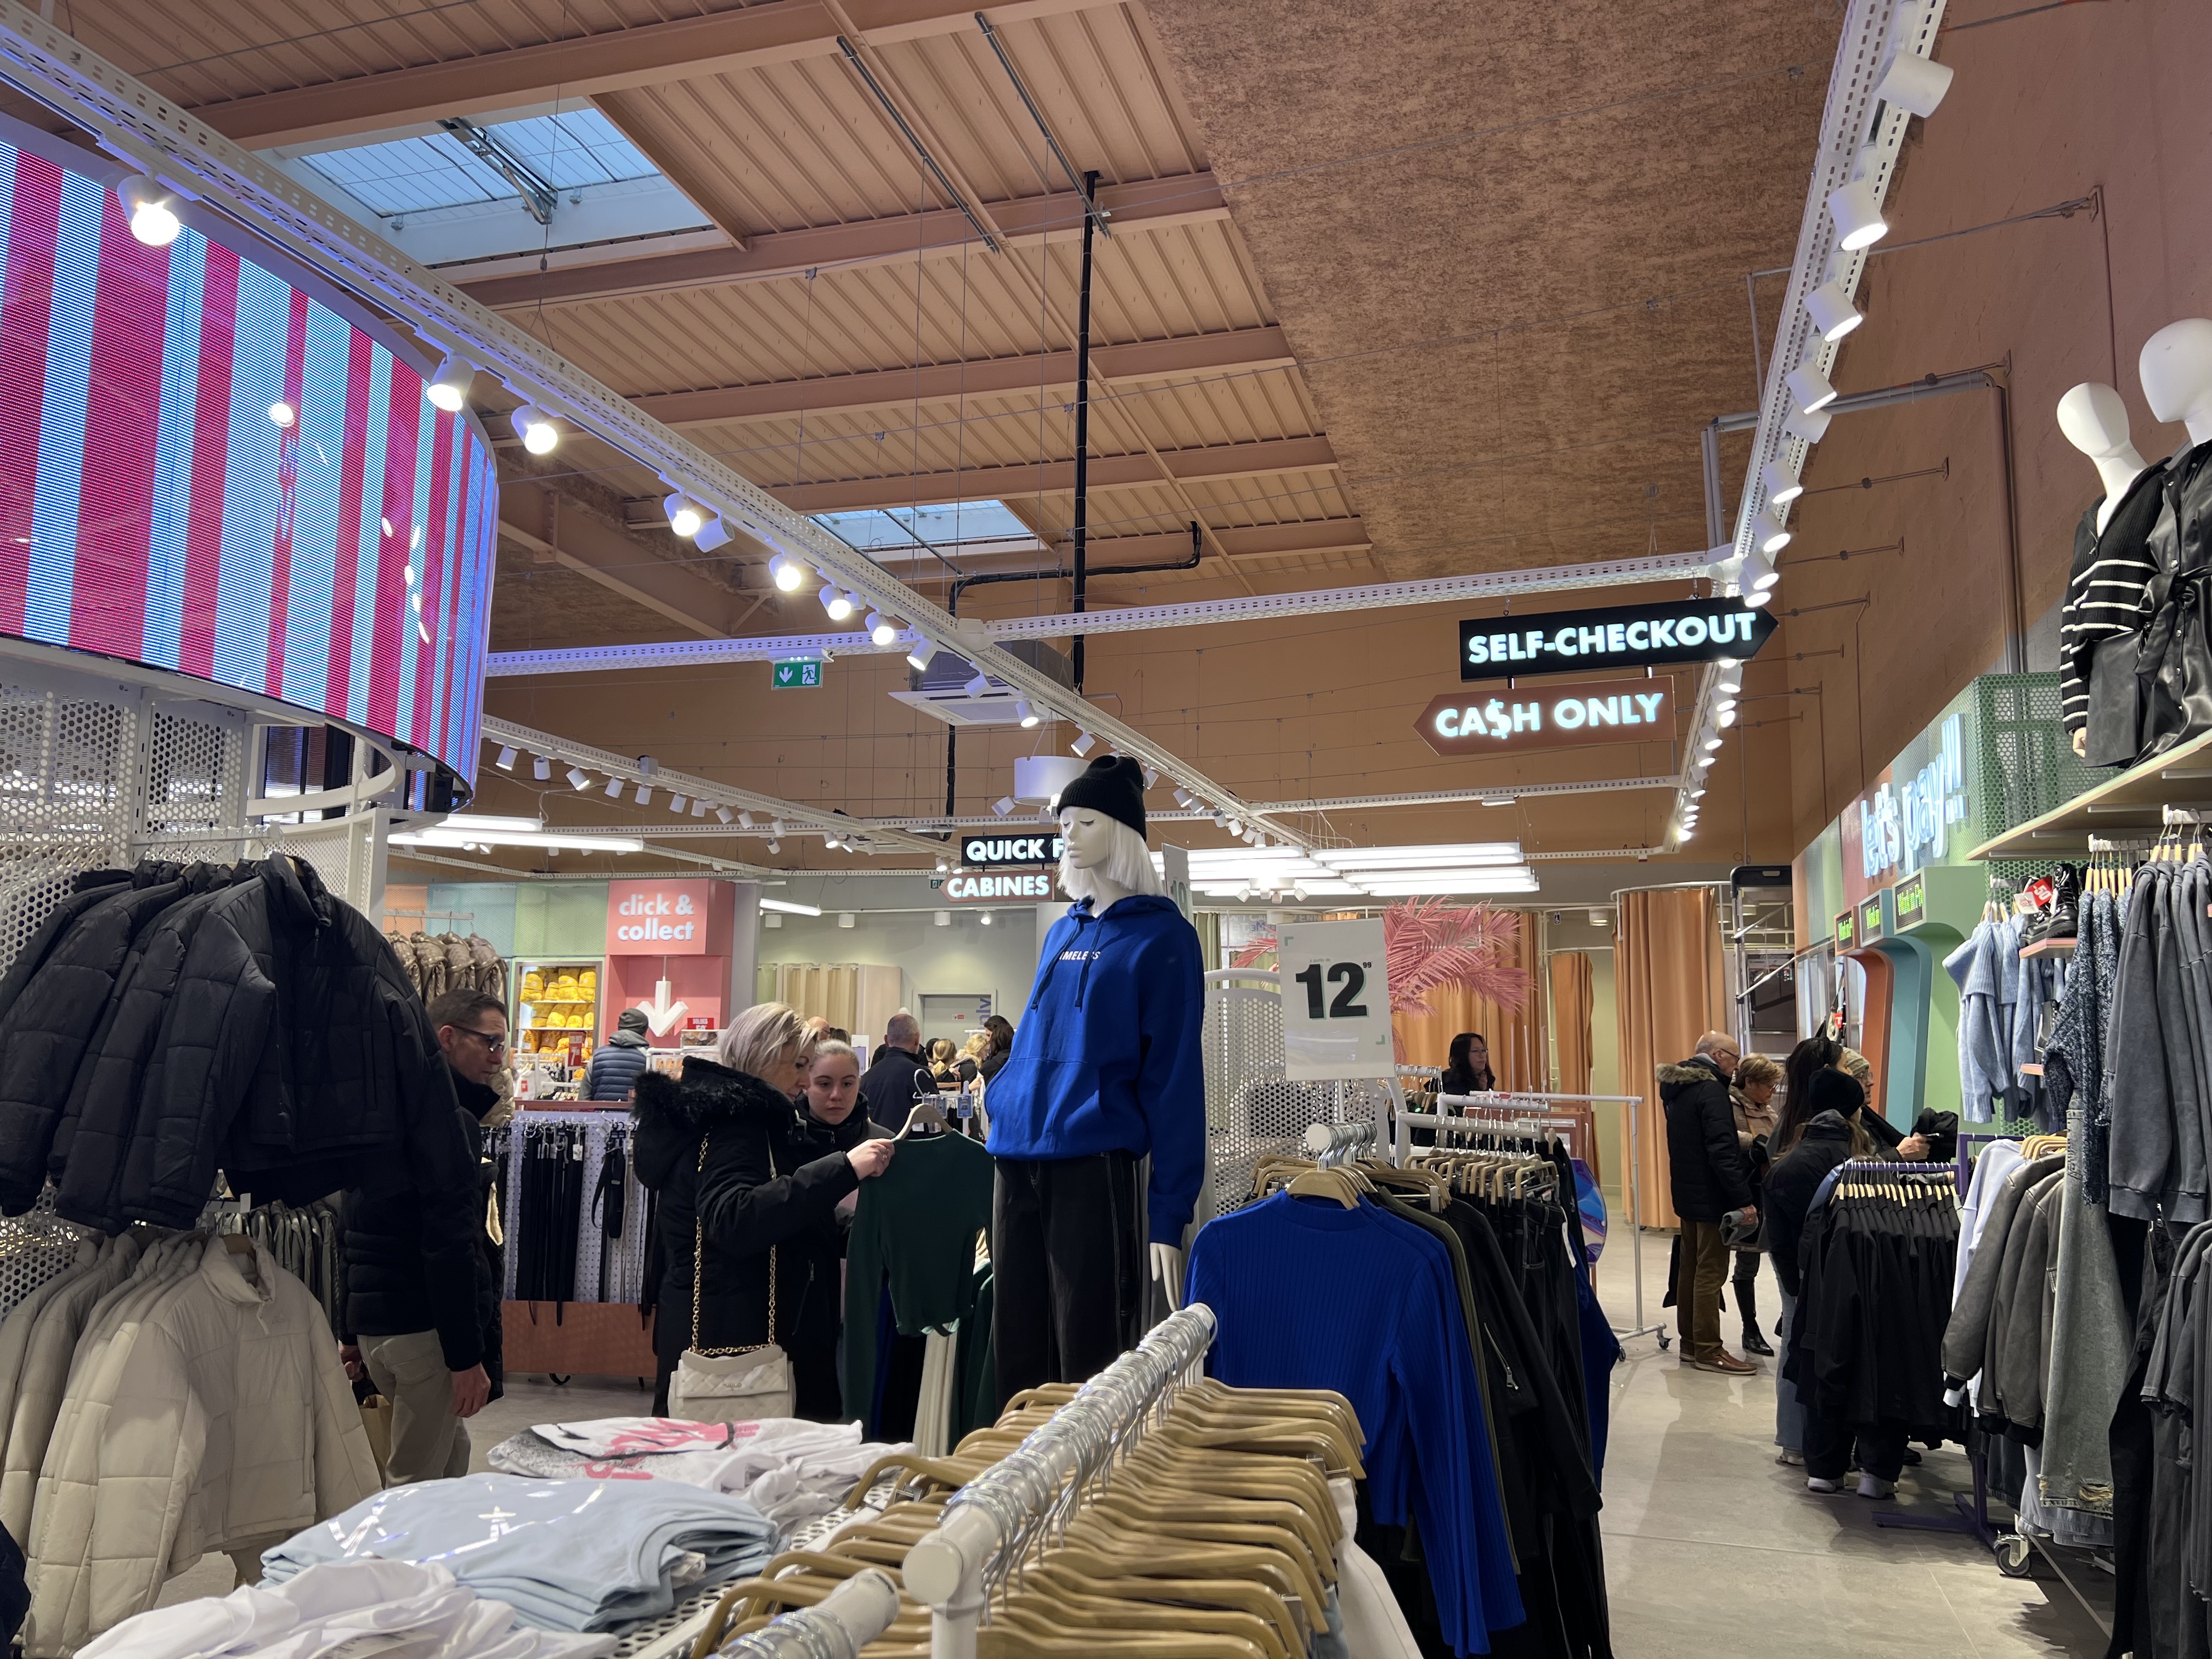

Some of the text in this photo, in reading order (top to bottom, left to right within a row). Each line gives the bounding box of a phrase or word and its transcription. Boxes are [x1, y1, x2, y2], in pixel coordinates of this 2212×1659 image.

[1468, 612, 1756, 664] SELF-CHECKOUT
[1436, 692, 1663, 738] CA$H ONLY
[1861, 782, 1899, 878] let's
[966, 839, 1045, 861] QUICK
[947, 875, 1050, 898] CABINES
[619, 893, 695, 916] click &
[618, 918, 694, 941] collect
[1059, 951, 1101, 960] IMELES
[1295, 962, 1369, 1019] 12
